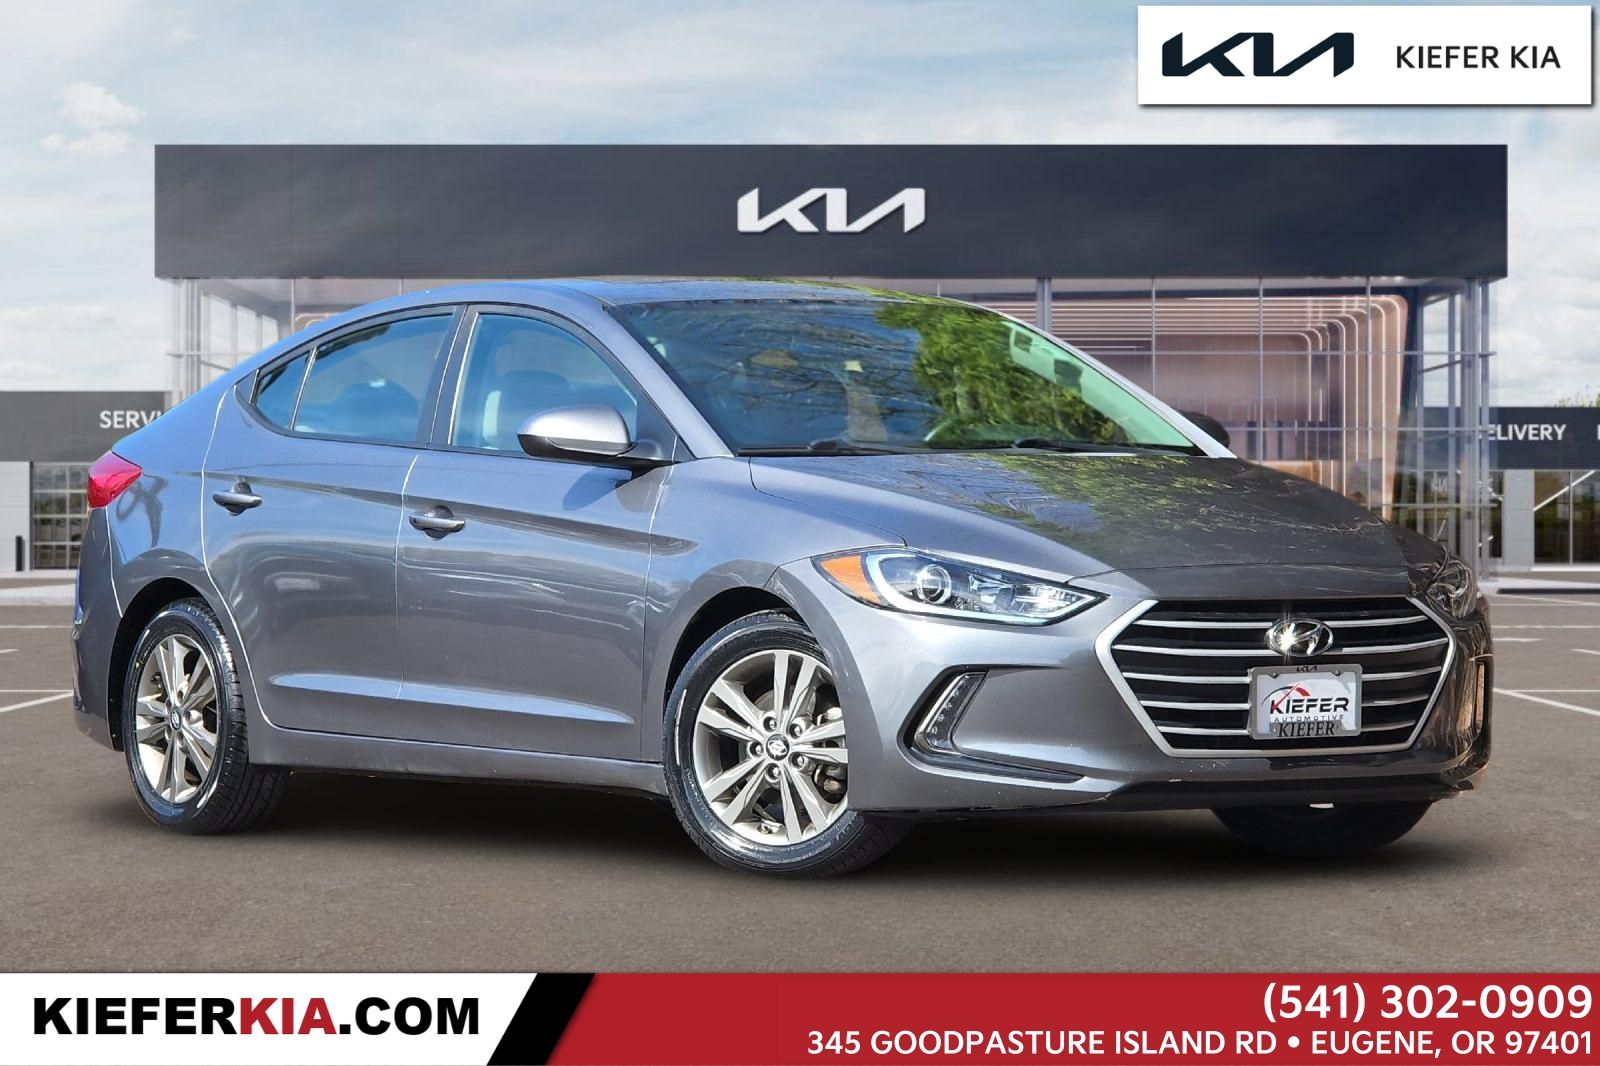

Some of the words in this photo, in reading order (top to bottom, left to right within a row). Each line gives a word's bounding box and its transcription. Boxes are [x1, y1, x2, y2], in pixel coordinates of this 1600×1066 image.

[1477, 424, 1567, 441] ELIVERY
[1270, 697, 1350, 714] KIEFER
[1274, 714, 1344, 723] AUTOMOTIVE
[1278, 721, 1335, 737] KIEFER
